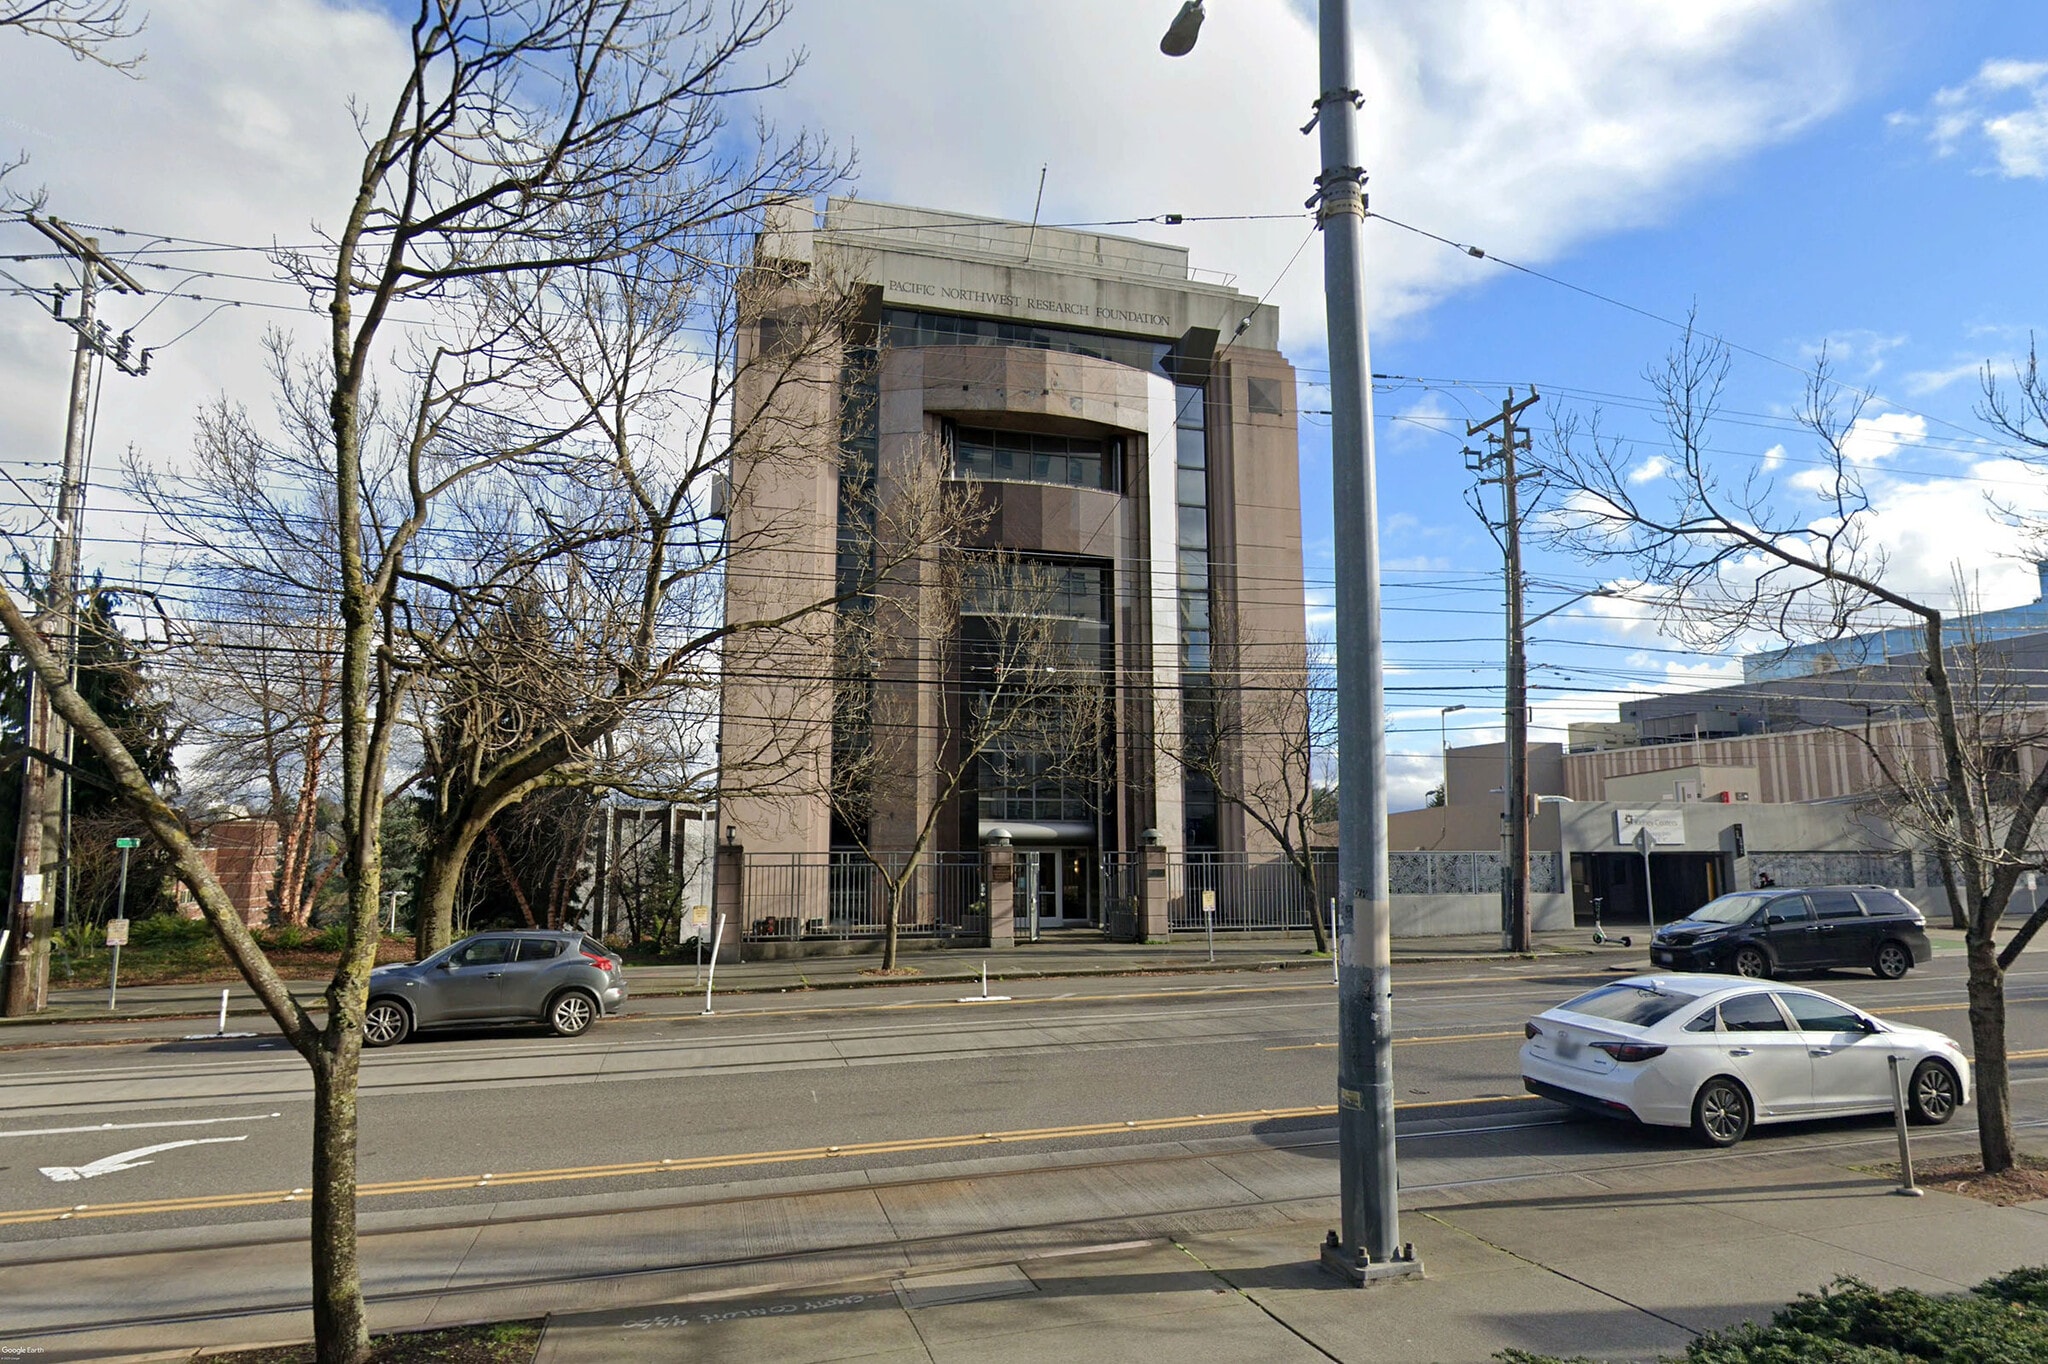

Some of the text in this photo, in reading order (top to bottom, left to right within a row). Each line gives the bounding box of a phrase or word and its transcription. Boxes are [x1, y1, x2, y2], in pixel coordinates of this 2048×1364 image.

[888, 280, 1171, 327] PACIFIC NORTHWEST RESEARCH FOUNDATION
